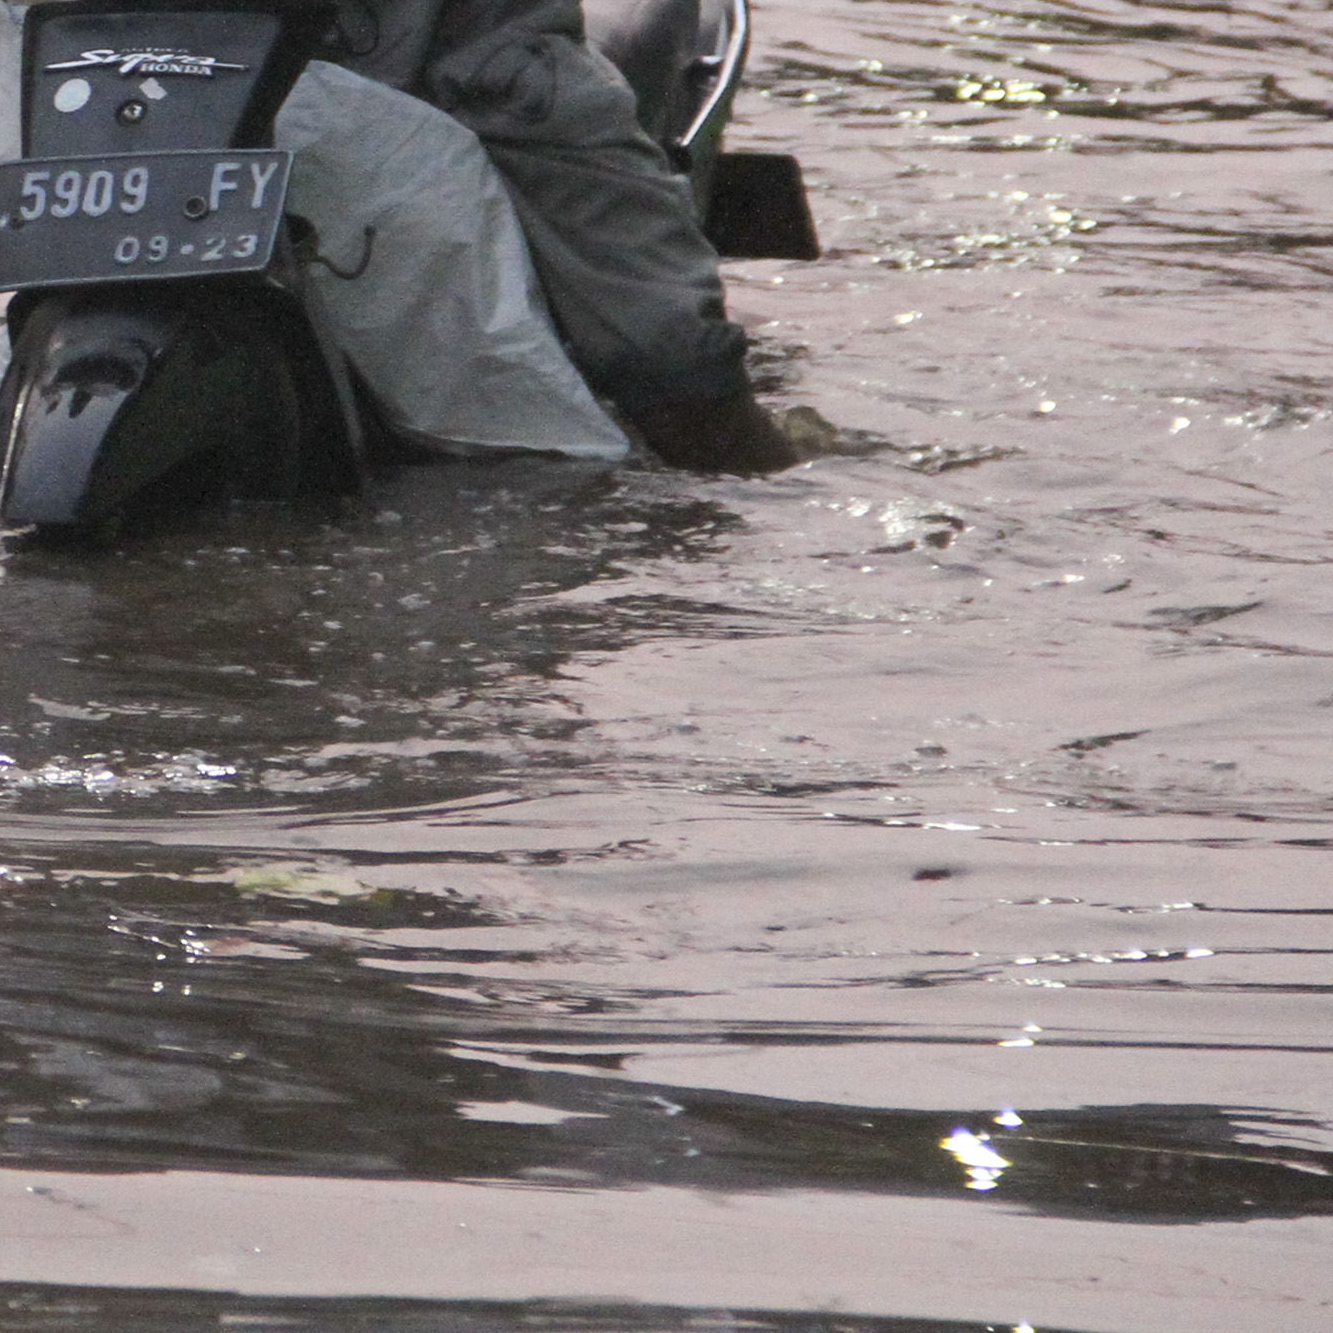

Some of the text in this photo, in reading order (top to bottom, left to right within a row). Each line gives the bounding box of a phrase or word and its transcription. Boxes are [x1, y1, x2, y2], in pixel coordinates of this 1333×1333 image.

[139, 63, 213, 76] HONDA
[20, 167, 149, 221] 5909
[209, 162, 279, 212] FY
